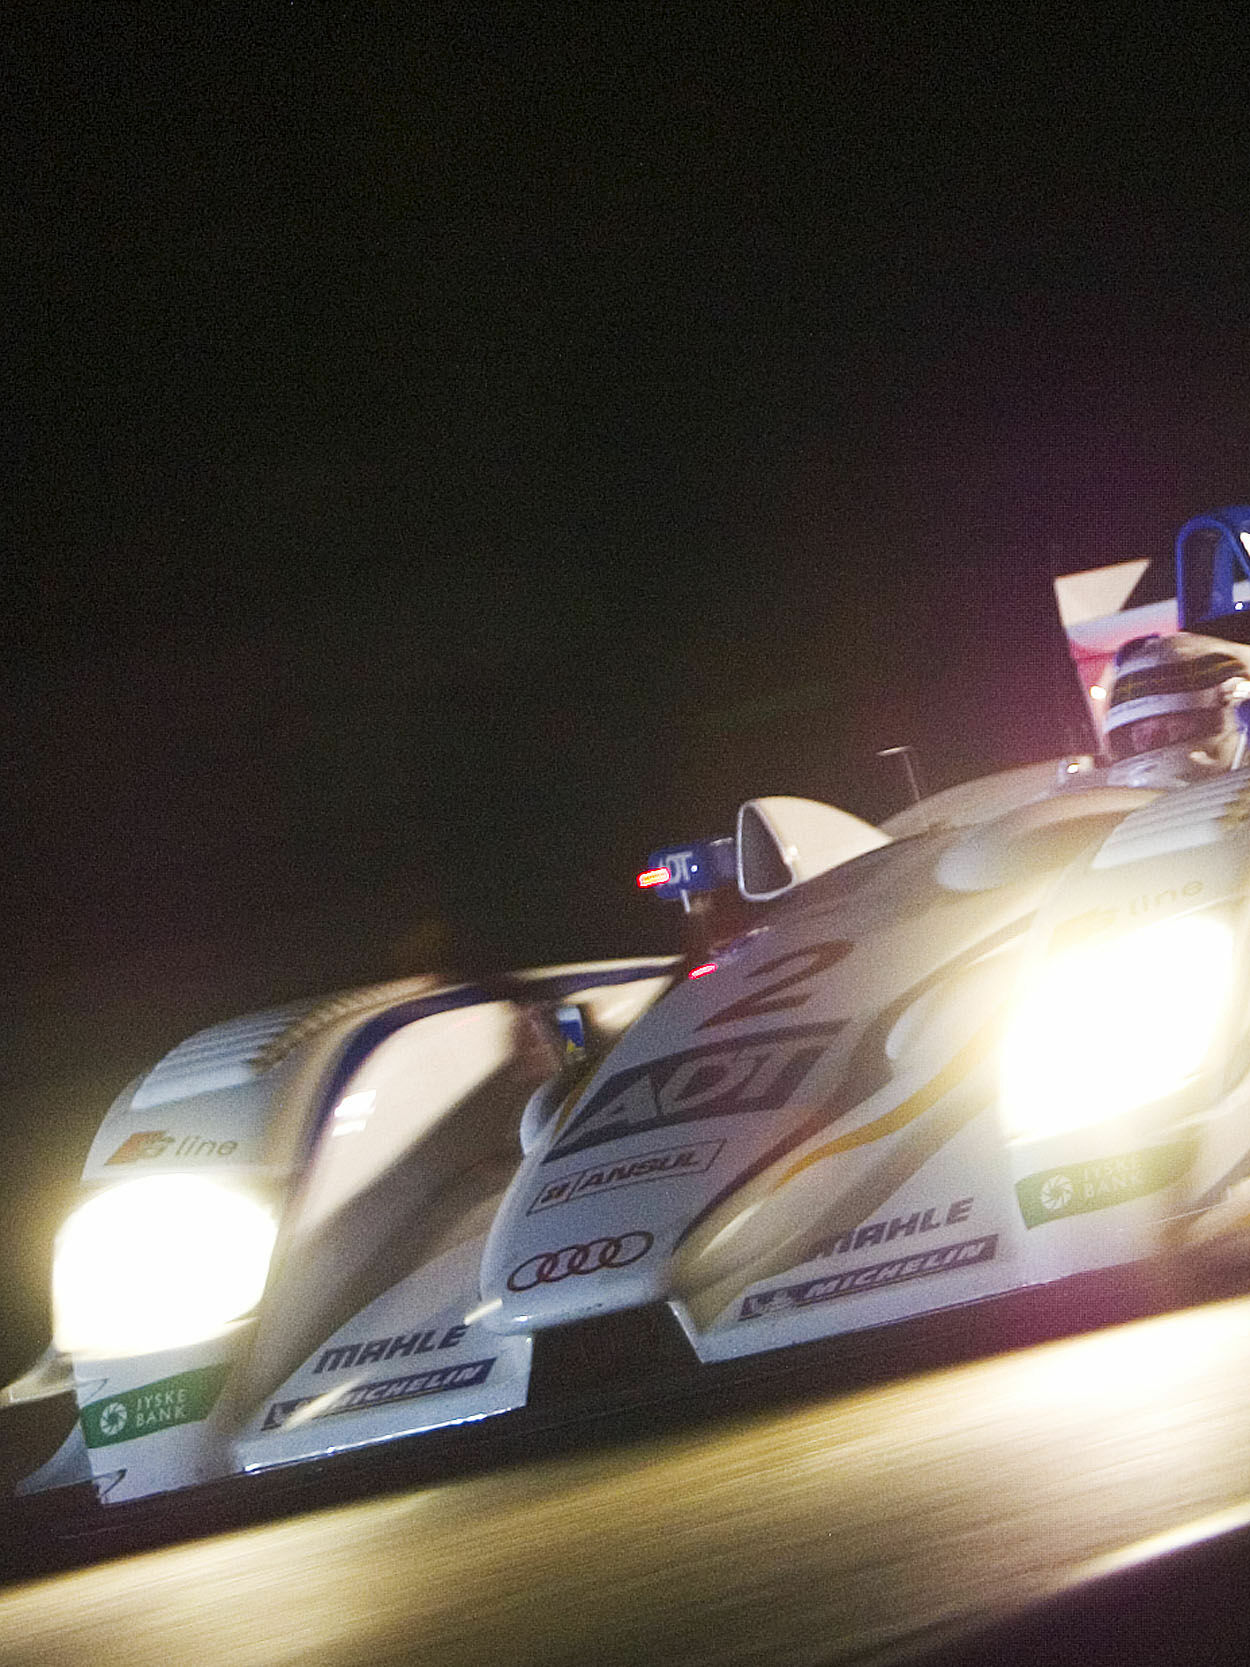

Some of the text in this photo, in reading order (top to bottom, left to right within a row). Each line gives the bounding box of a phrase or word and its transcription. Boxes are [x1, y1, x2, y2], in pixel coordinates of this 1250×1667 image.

[695, 938, 856, 1033] 2
[552, 1043, 830, 1146] ADT
[1084, 1175, 1144, 1199] BANK
[804, 1242, 988, 1300] MICHELIN
[312, 1323, 470, 1375] MAHLE
[135, 1405, 187, 1428] BANK
[137, 1388, 187, 1412] JYSKE
